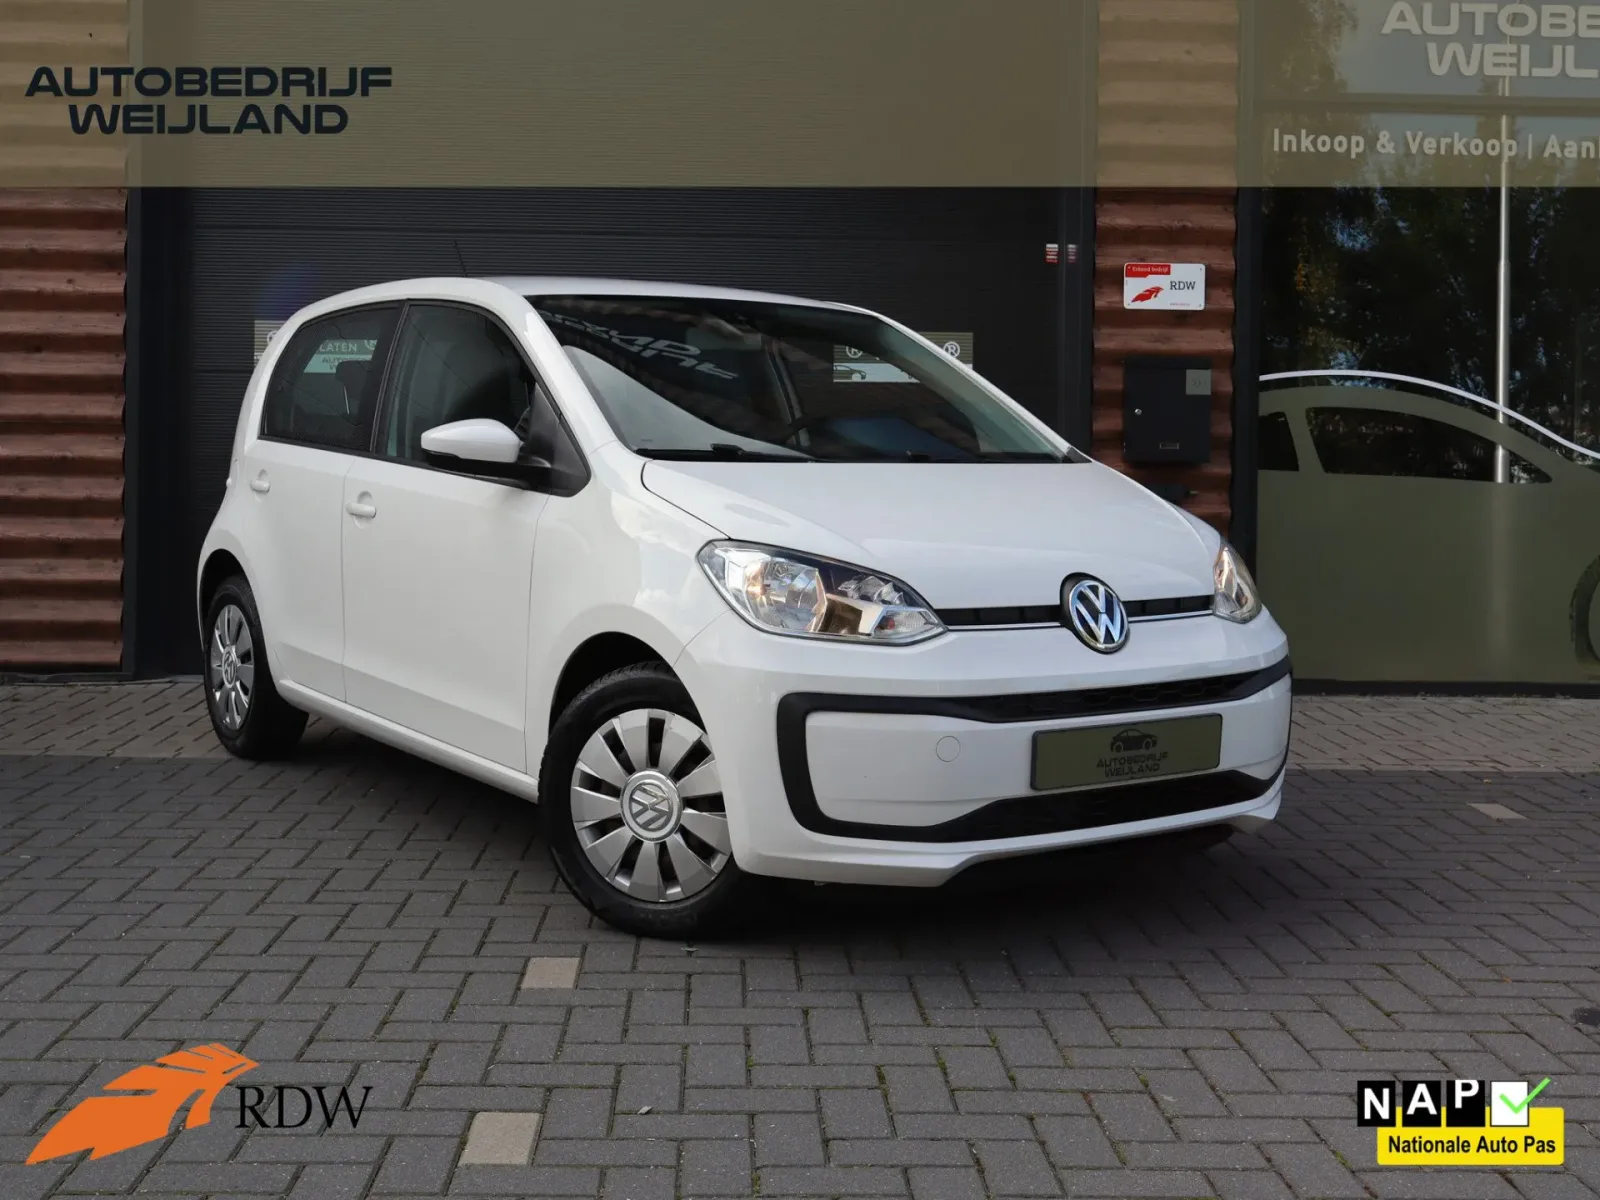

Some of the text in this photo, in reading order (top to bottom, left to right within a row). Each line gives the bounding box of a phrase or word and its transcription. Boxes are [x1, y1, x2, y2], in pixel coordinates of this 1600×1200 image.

[1273, 128, 1365, 158] Inkoop
[1376, 130, 1396, 154] &
[1406, 131, 1518, 160] Verkoop
[1543, 134, 1600, 159] Aan
[1170, 281, 1196, 291] RDW
[1097, 752, 1168, 768] AUTOBEDRIJF
[1104, 763, 1160, 777] WEIJLAND
